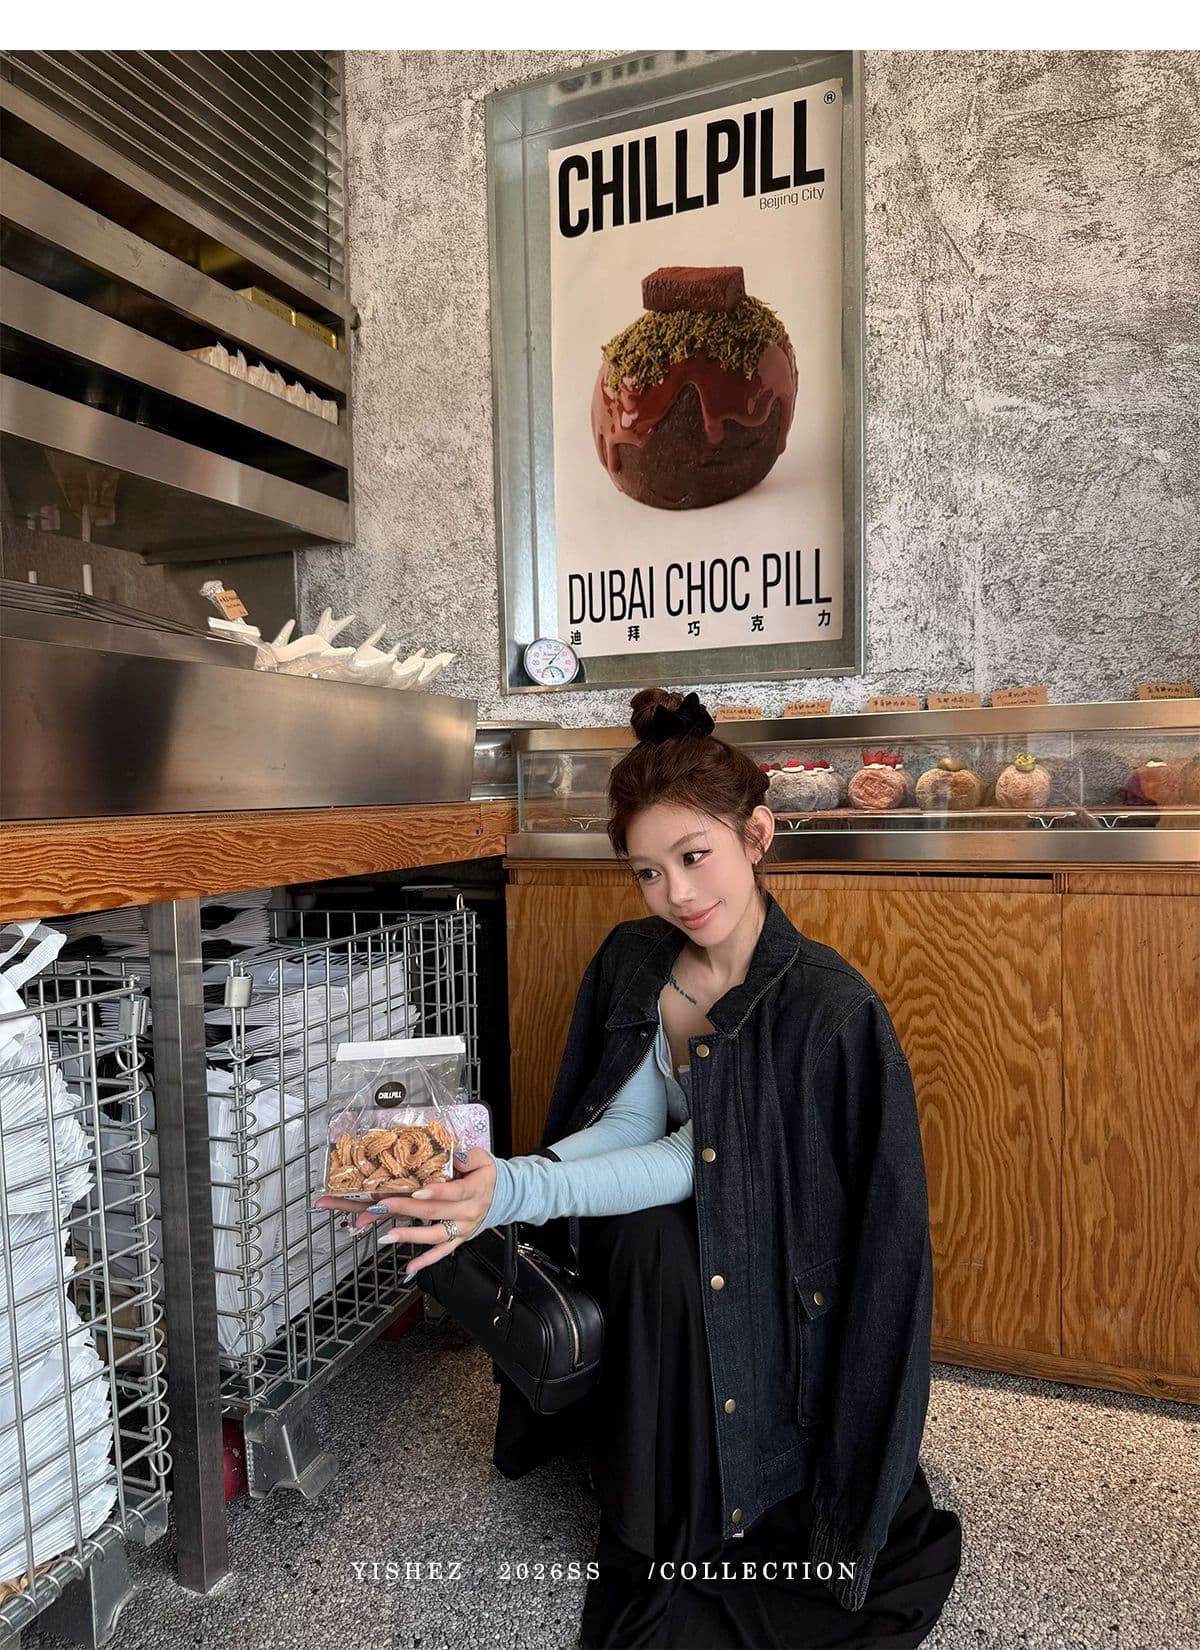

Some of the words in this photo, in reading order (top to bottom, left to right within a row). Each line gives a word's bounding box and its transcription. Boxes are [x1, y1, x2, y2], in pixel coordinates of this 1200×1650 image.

[558, 99, 825, 239] CHILLPILL
[759, 192, 799, 210] Beijing
[801, 186, 825, 203] City
[568, 566, 655, 625] DUBAI
[665, 555, 751, 617] CHOC
[762, 548, 833, 609] PILL
[569, 610, 831, 646] 迪拜巧克力
